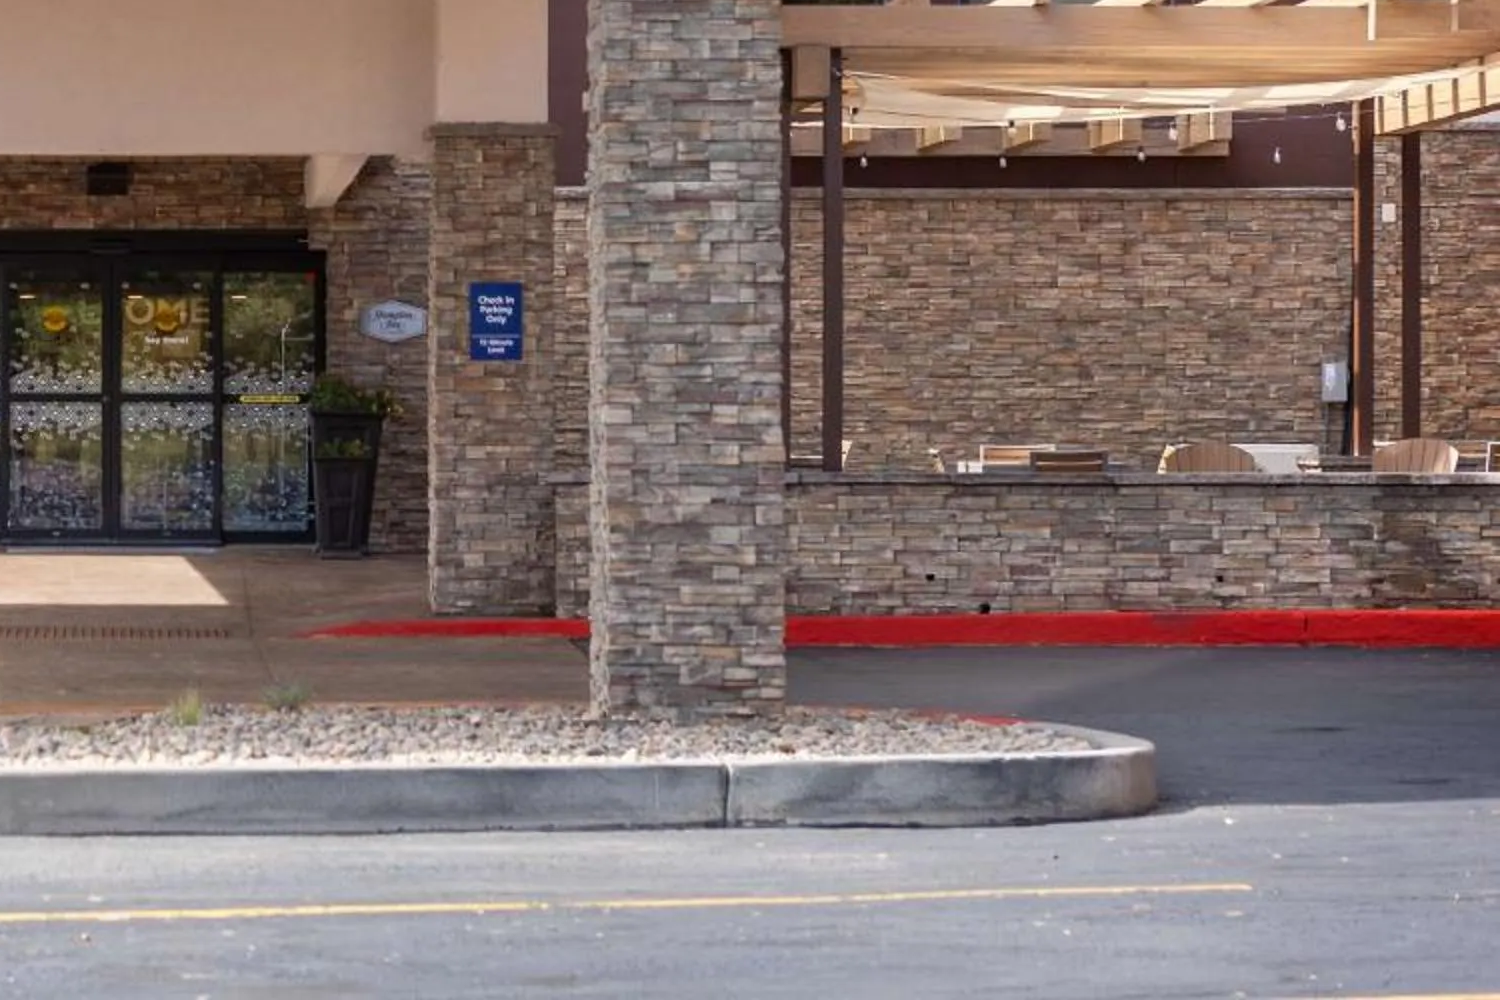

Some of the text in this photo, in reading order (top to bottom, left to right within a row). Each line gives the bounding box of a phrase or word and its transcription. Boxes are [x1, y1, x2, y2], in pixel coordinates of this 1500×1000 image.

[478, 295, 515, 305] Check In
[479, 306, 514, 317] Parking
[485, 315, 507, 326] Only
